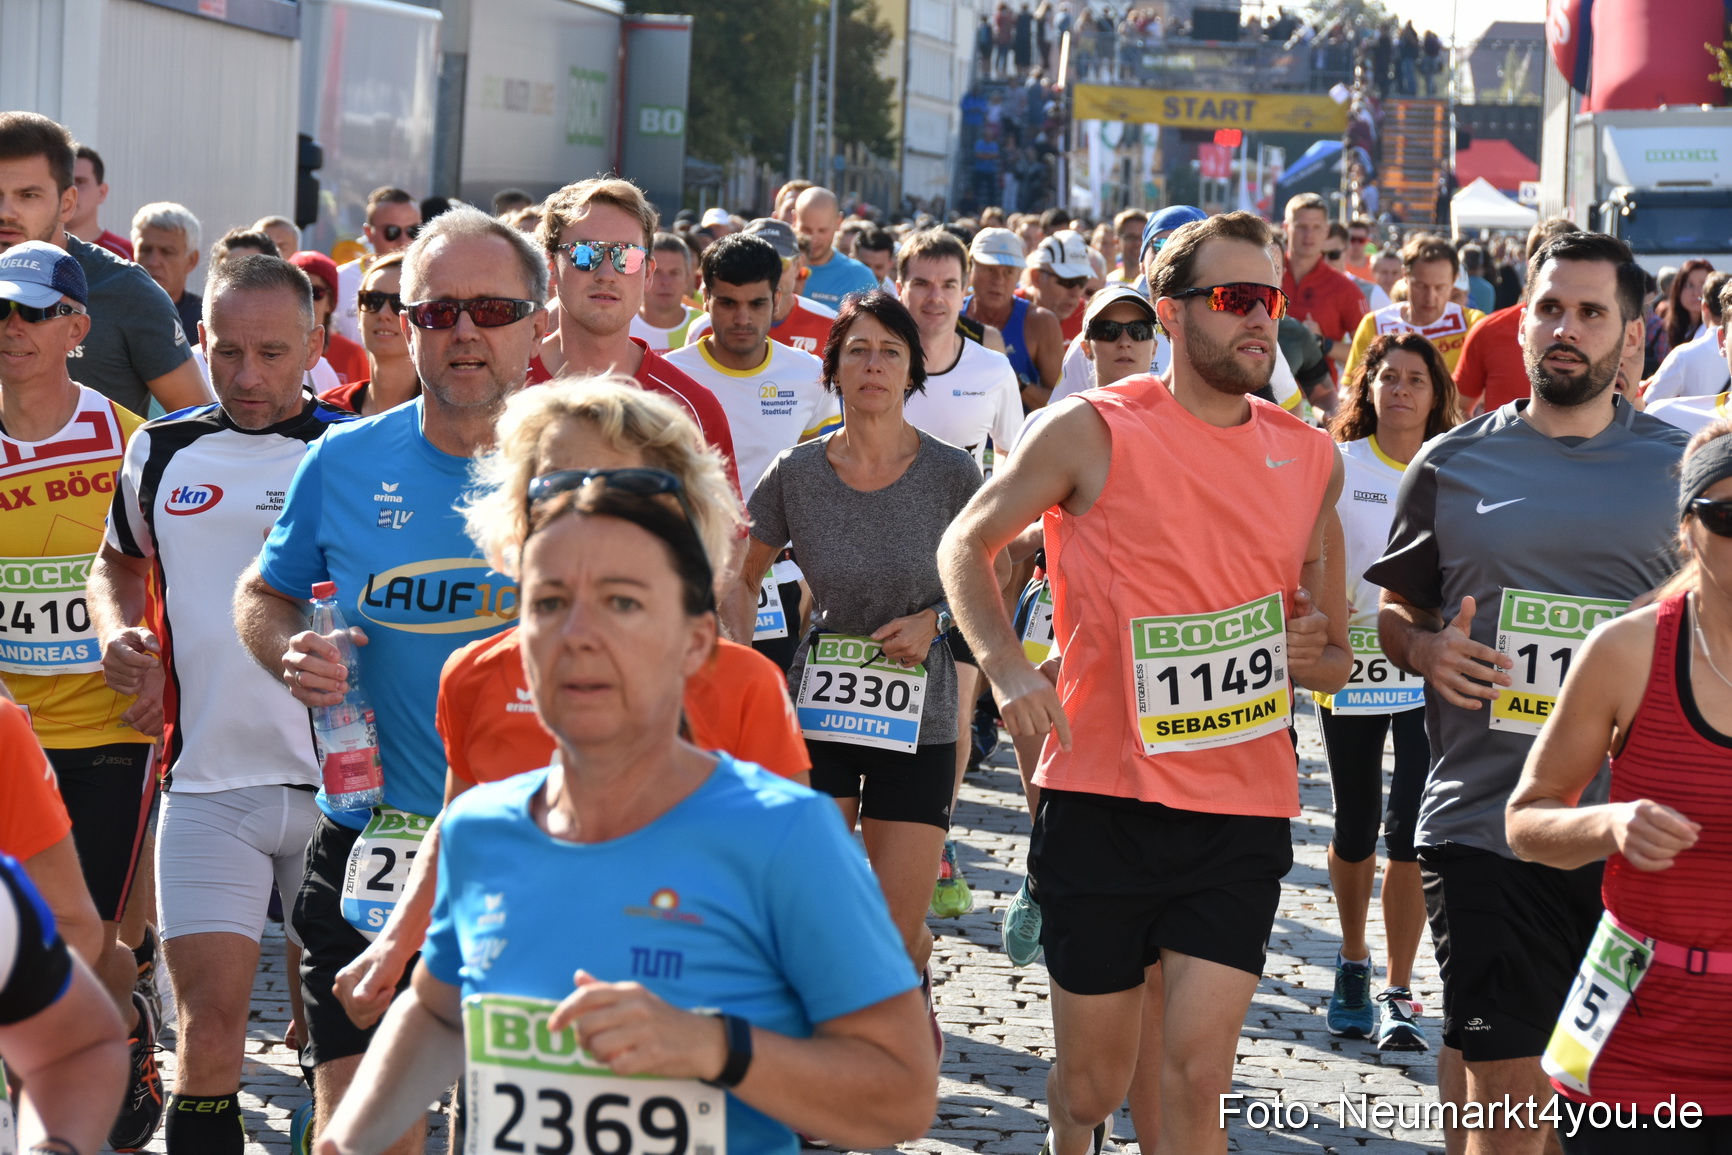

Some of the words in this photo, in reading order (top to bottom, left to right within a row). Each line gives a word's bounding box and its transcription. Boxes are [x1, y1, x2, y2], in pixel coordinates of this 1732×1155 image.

[1163, 96, 1258, 121] START
[640, 106, 682, 136] BO
[761, 386, 777, 398] 20
[762, 408, 792, 416] Stadtlauf
[170, 486, 207, 504] tkn
[374, 494, 403, 503] erima
[1354, 490, 1387, 501] BOCK
[0, 560, 91, 590] OCK
[1146, 603, 1274, 653] BOCK
[1274, 645, 1281, 653] C
[1156, 648, 1273, 705] 1149
[812, 670, 911, 712] 2330
[1347, 691, 1425, 704] MANUELA
[820, 713, 890, 735] JUDITH
[1156, 698, 1276, 737] SEBASTIAN
[106, 756, 133, 766] asics
[630, 946, 684, 980] TUM
[178, 1099, 229, 1114] cep
[493, 1083, 690, 1155] 2369
